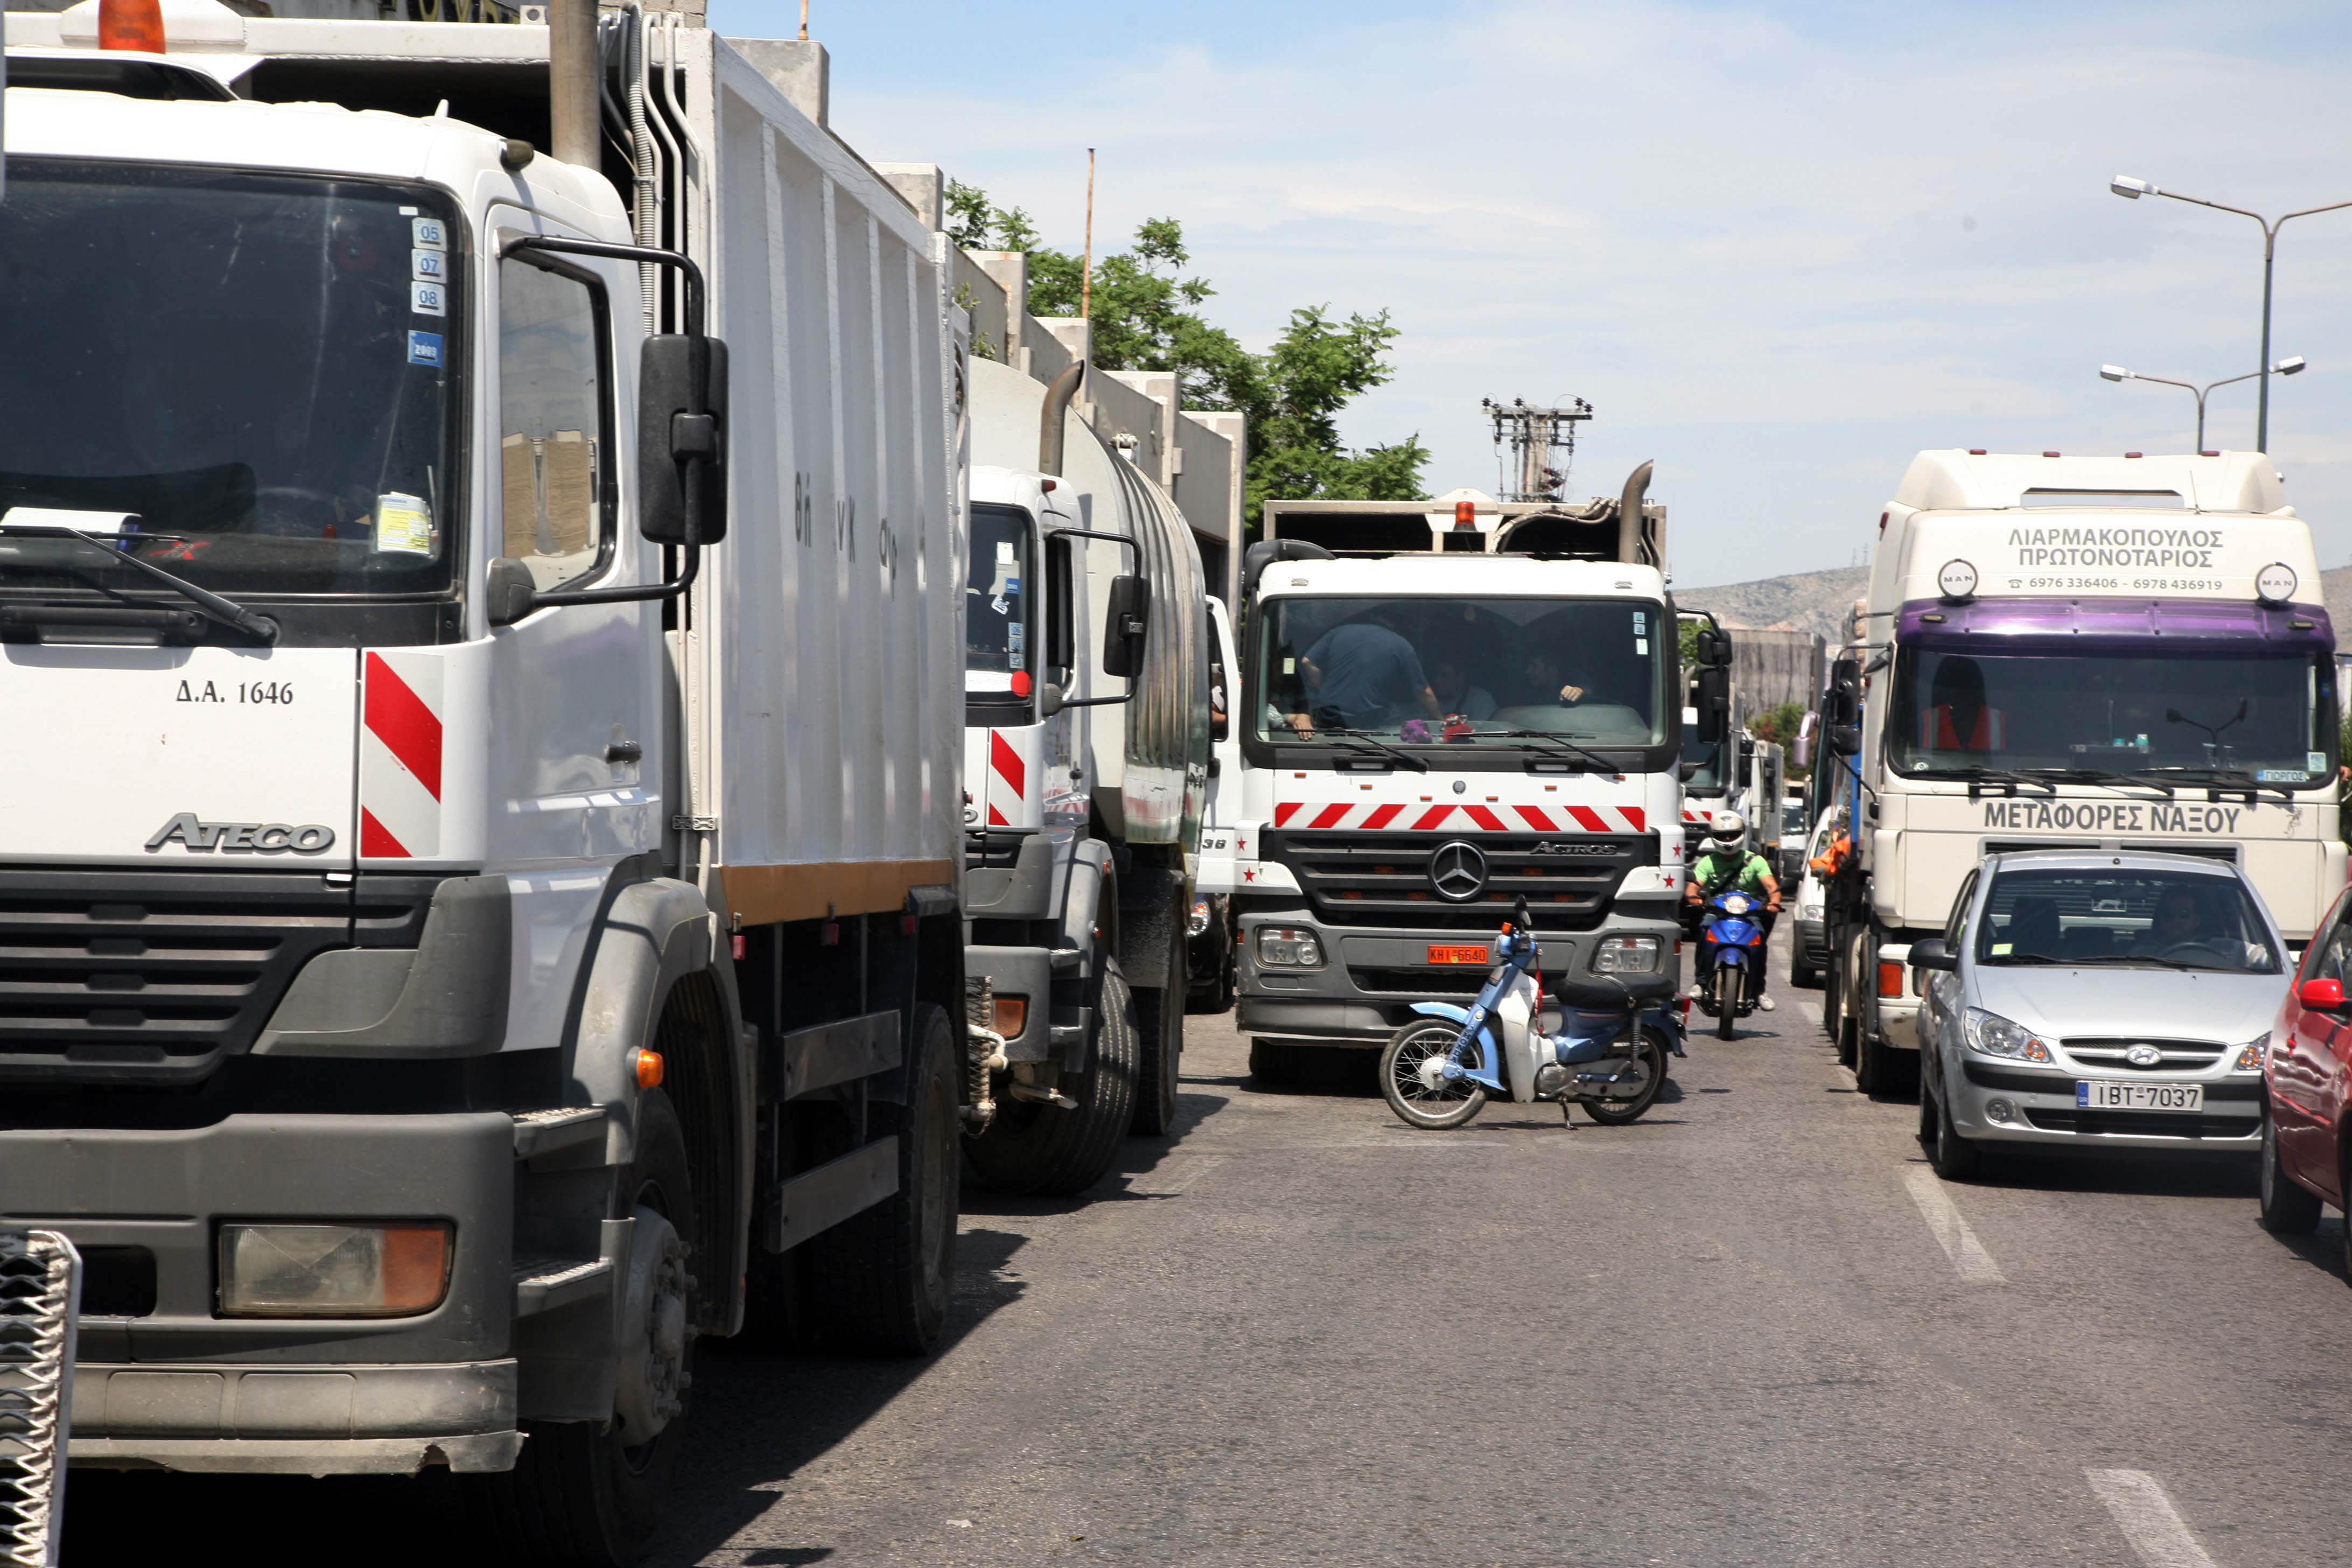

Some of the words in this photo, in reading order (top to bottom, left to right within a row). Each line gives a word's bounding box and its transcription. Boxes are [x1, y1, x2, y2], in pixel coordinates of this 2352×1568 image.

[420, 225, 439, 241] 05
[421, 257, 439, 272] 07
[419, 289, 437, 305] 08
[2008, 528, 2224, 548] ΛΙΑΡΜΑΚΟΠΟΥΛΟΣ
[2019, 548, 2214, 568] ΠΡΩΤΟΝΟΤΑΡΙΟΣ
[1943, 575, 1973, 583] MAN
[2029, 578, 2063, 588] 6976
[2067, 578, 2118, 589] 336406
[2133, 579, 2167, 589] 6978
[2170, 579, 2223, 590] 436919
[237, 681, 293, 705] 1646
[1984, 802, 2143, 831] ΜΕΤΑΦΟΡΕΣ
[2151, 807, 2241, 833] ΝΑΞΟΥ
